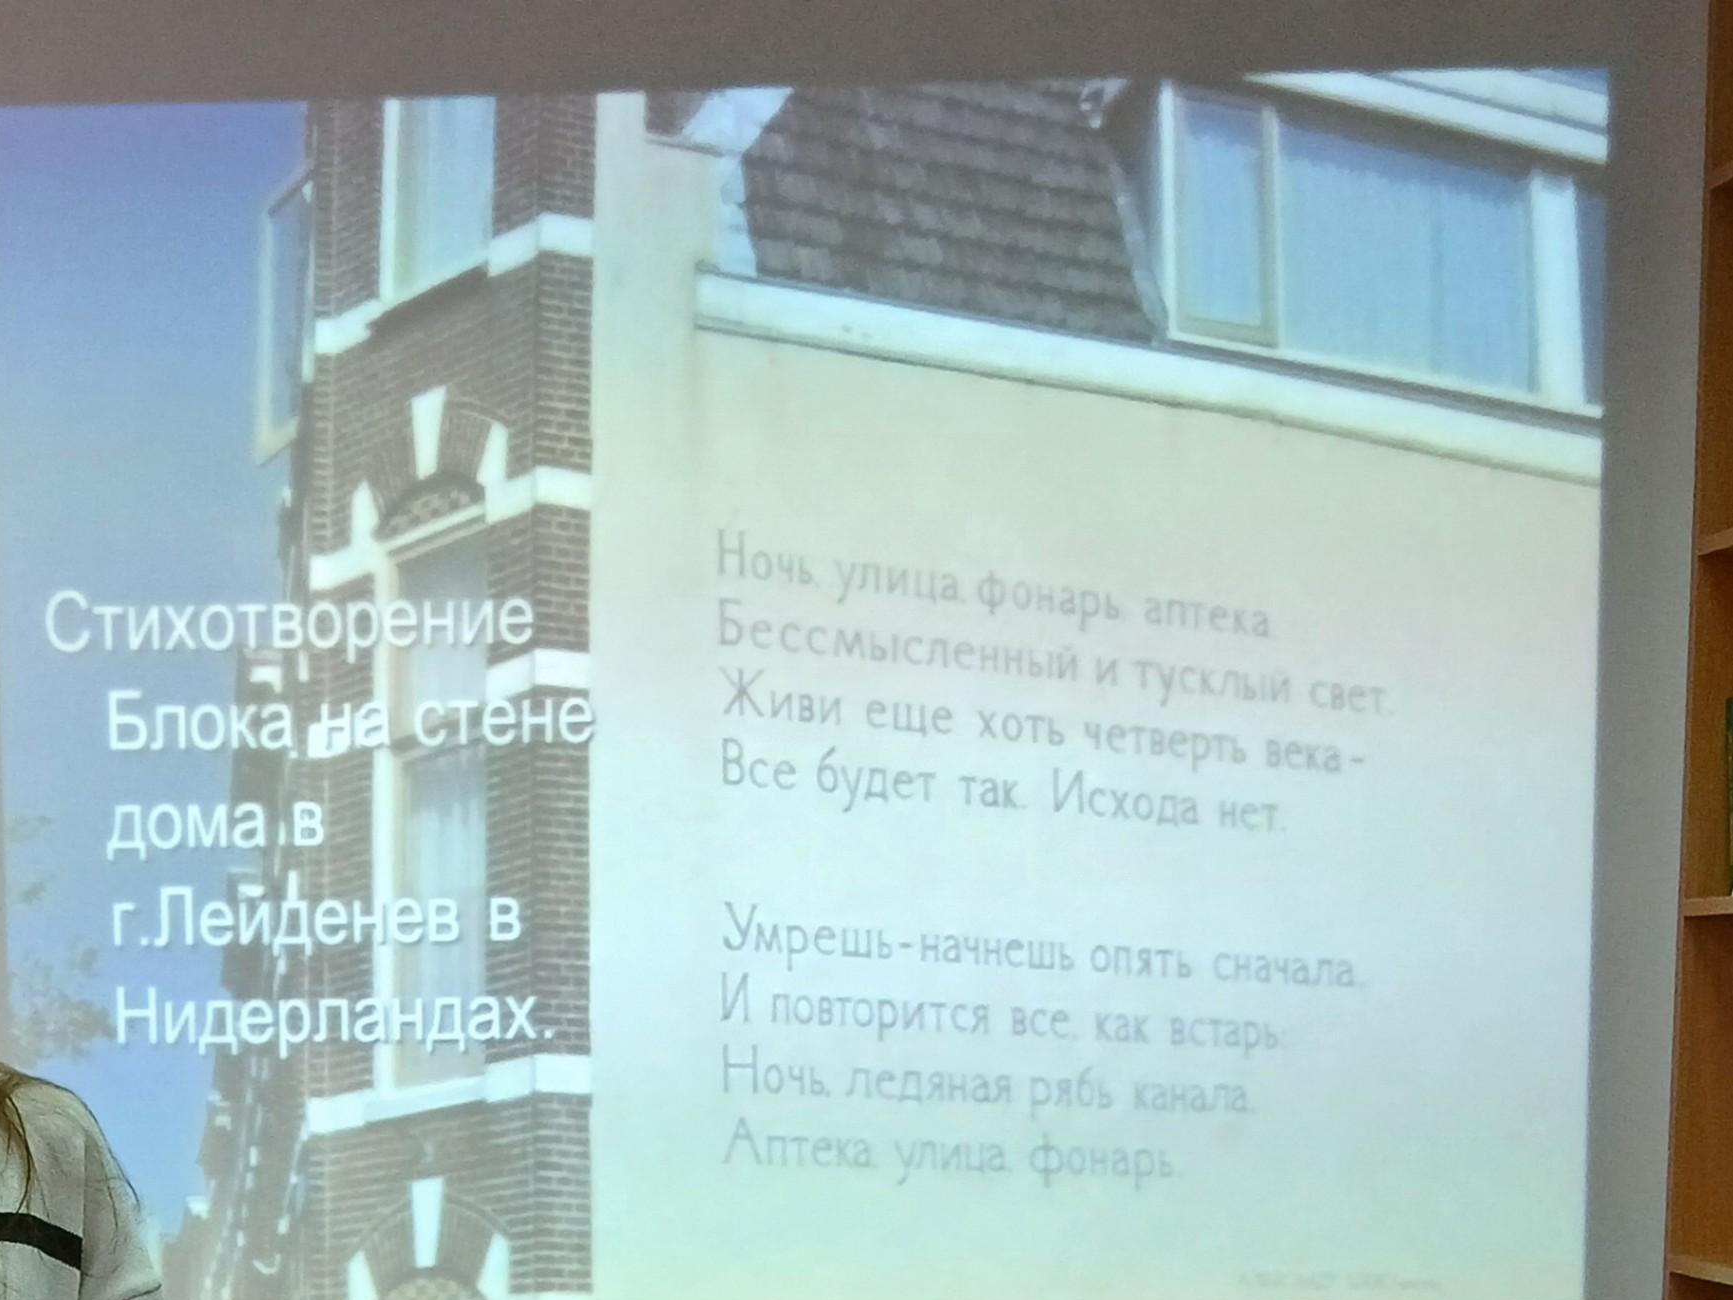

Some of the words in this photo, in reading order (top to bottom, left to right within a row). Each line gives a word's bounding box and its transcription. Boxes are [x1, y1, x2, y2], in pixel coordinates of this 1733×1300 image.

[44, 589, 535, 663] Стихотворение
[718, 597, 1079, 682] Бессмысленный
[1095, 653, 1119, 686] и
[1134, 654, 1290, 706] тусклый
[107, 688, 294, 752] Блока
[318, 699, 391, 747] на
[413, 693, 596, 746] стене
[719, 665, 842, 728] Живи
[865, 693, 953, 738] еще
[978, 705, 1066, 748] хоть
[1083, 716, 1248, 772] четверть
[720, 737, 796, 790] Все
[815, 745, 936, 812] будет
[1052, 768, 1201, 828] Исхода
[106, 800, 267, 860] дома
[291, 798, 325, 847] в
[111, 885, 460, 956] г.Лейденев
[488, 894, 523, 942] в
[1089, 941, 1194, 981] опять
[115, 985, 556, 1058] Нидерландах.
[720, 972, 752, 1025] И
[770, 993, 991, 1041] повторится
[1094, 1007, 1151, 1047] как
[845, 1063, 1013, 1106] ледяная
[1029, 1066, 1114, 1121] рябь
